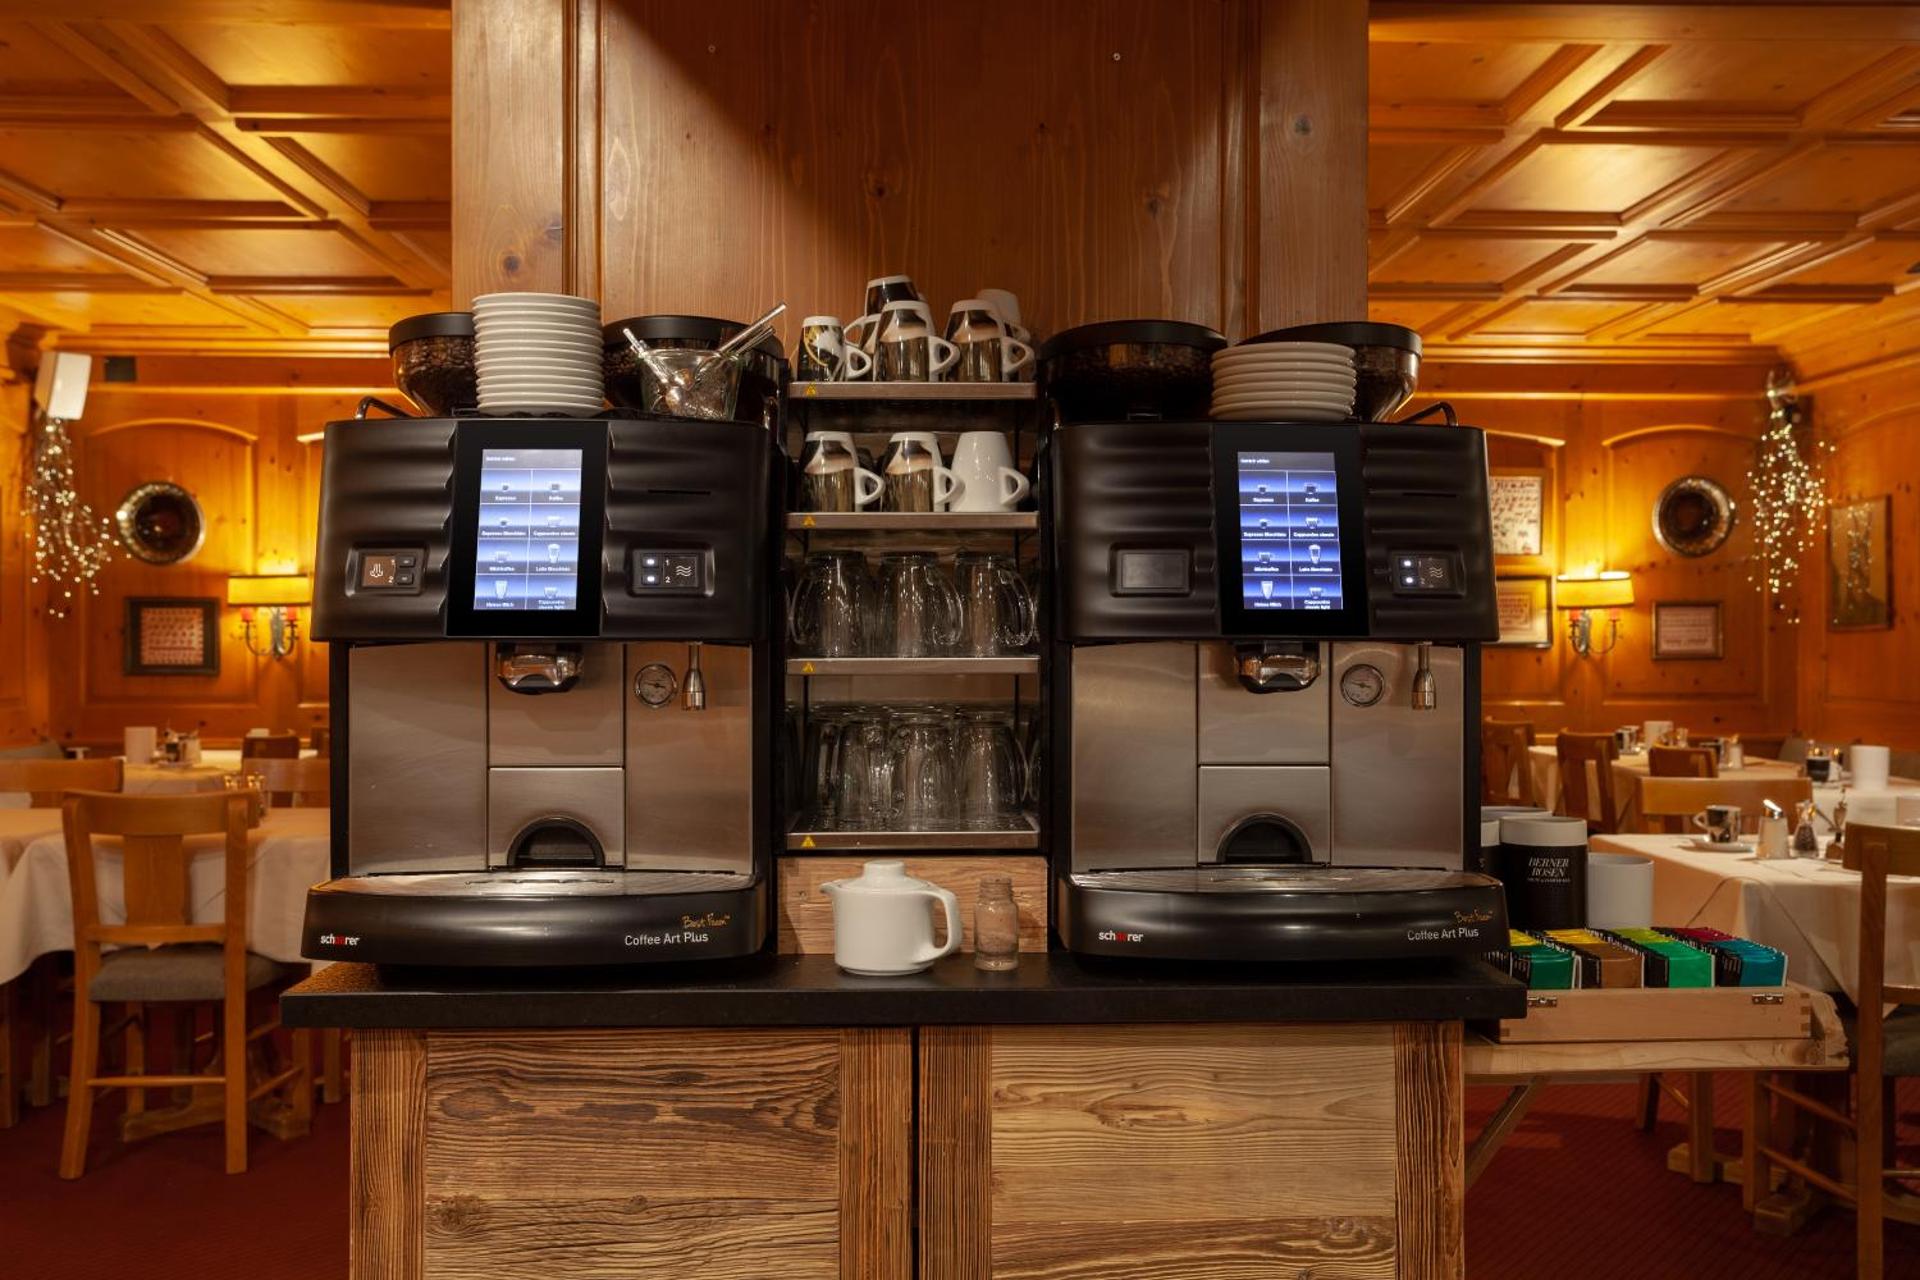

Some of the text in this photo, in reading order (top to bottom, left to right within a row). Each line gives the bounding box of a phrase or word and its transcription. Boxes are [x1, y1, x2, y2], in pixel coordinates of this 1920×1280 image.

[1528, 857, 1569, 867] BERNER
[1532, 868, 1565, 877] ROSEN
[320, 933, 360, 945] schrer
[624, 931, 709, 946] Coffee Art Plus
[1098, 930, 1143, 942] schrer
[1407, 927, 1479, 941] Coffee Art Plus
